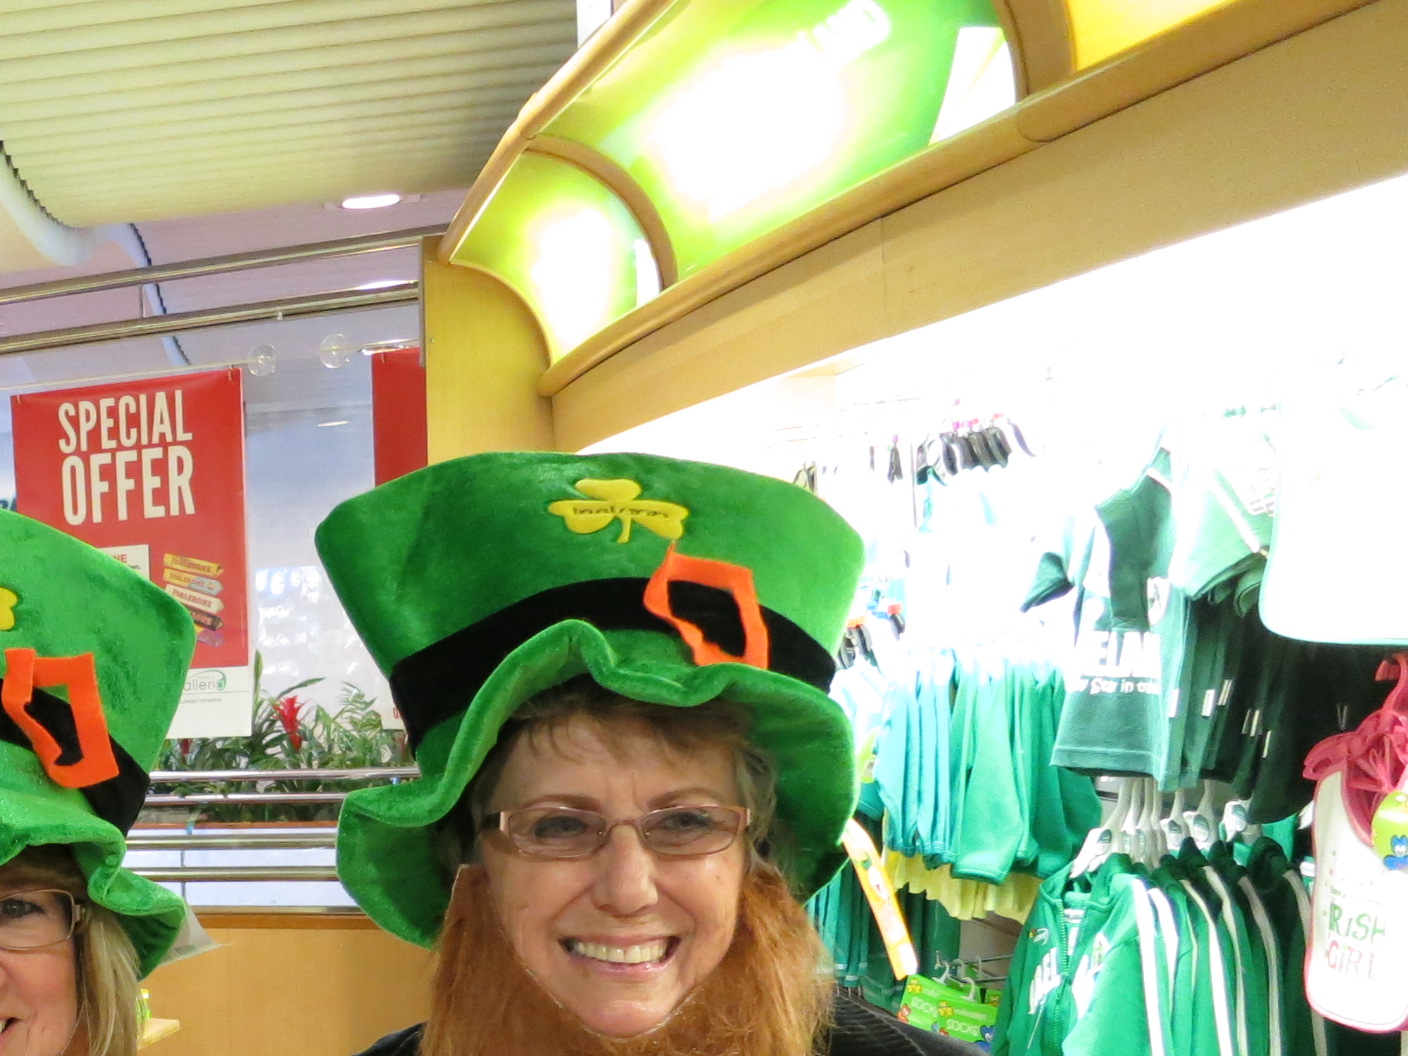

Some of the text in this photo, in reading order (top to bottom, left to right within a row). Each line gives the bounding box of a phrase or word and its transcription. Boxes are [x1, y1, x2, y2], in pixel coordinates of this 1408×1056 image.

[58, 389, 193, 455] SPECIAL
[61, 445, 195, 526] OFFER
[1121, 680, 1134, 693] in
[947, 1019, 978, 1036] SOCKS
